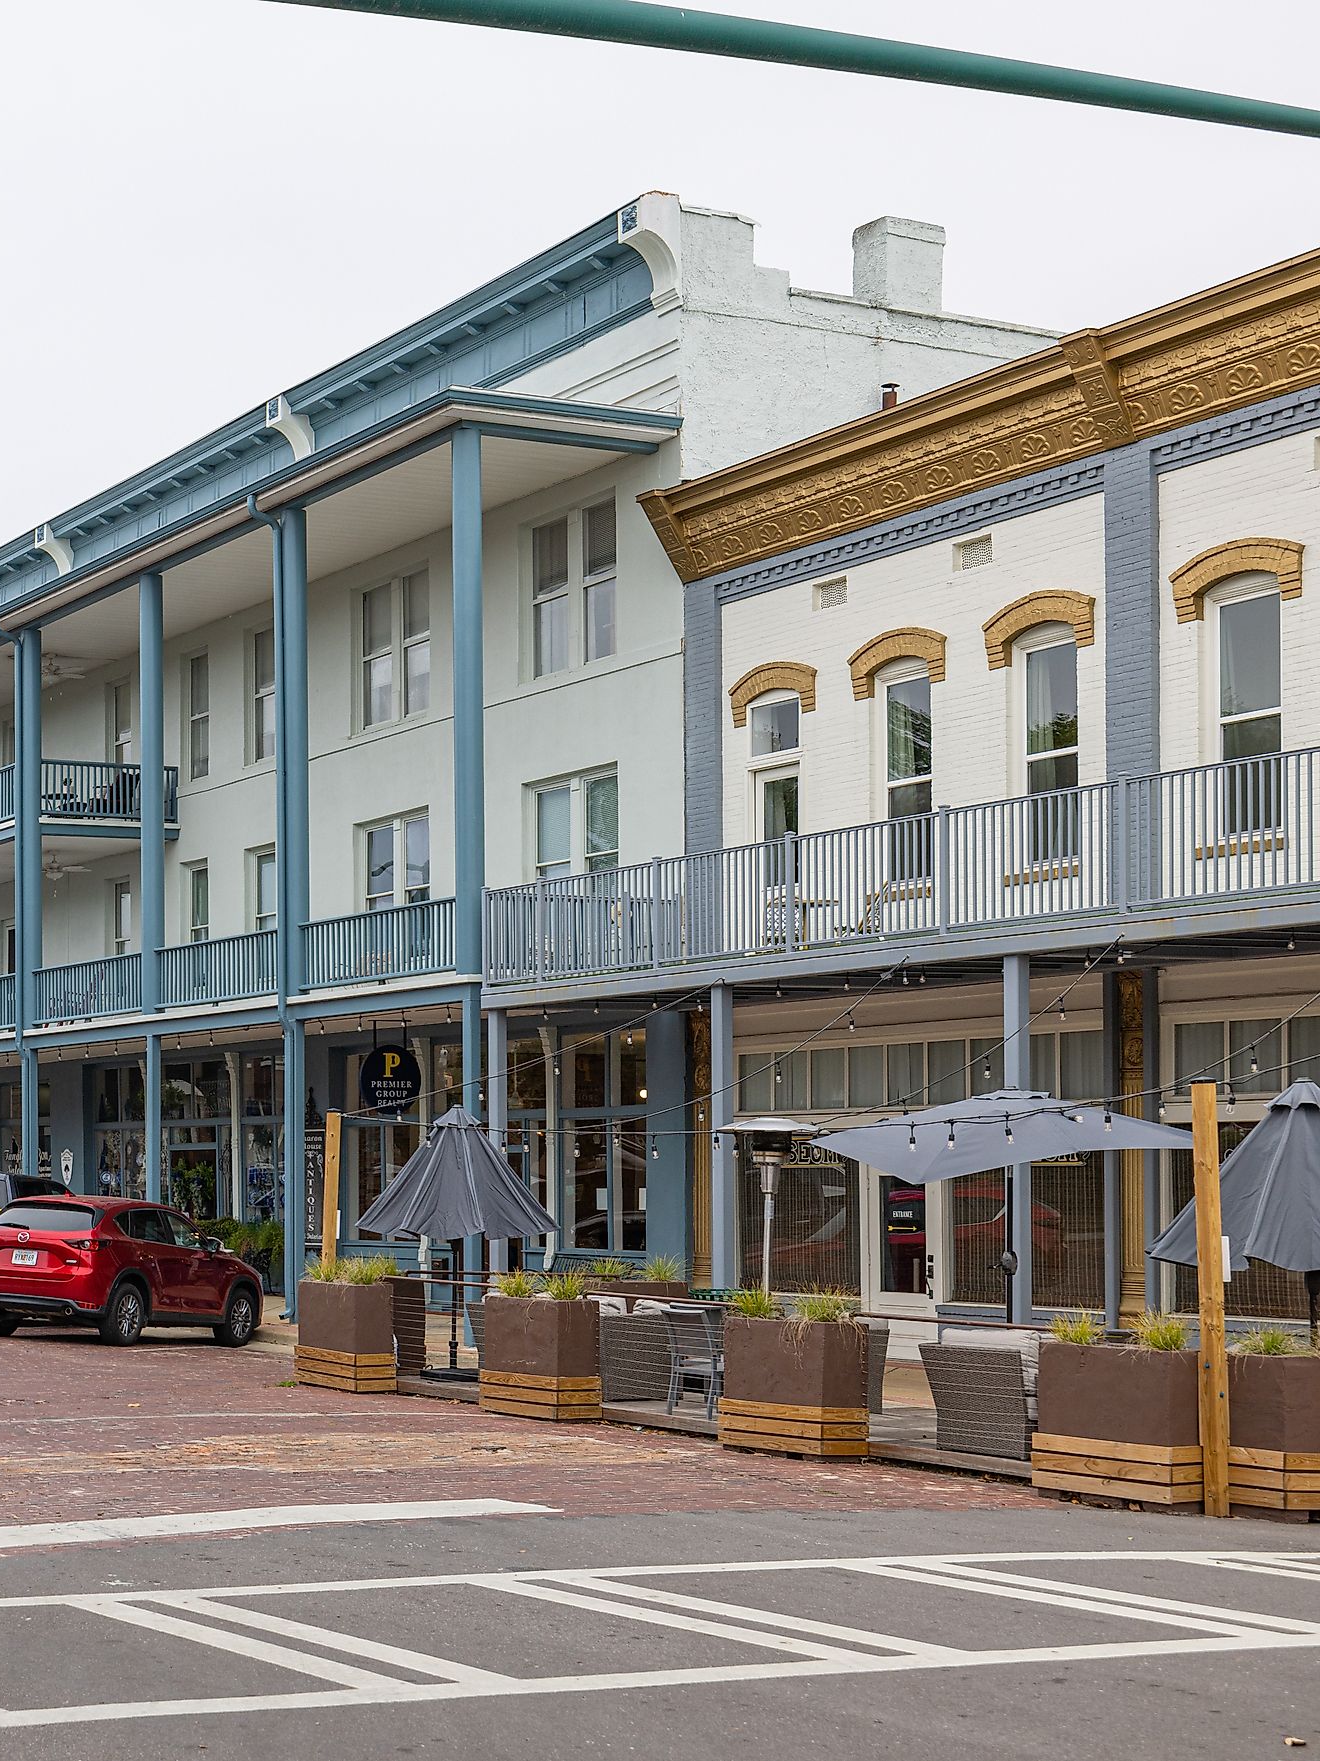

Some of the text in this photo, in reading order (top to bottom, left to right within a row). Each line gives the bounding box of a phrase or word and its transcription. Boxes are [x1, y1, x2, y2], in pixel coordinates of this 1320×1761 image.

[382, 1052, 401, 1078] P
[370, 1080, 413, 1089] PREMIER
[375, 1090, 408, 1098] GROUP
[307, 1161, 315, 1232] ANTIQUES
[892, 1210, 913, 1218] ENTRANCE
